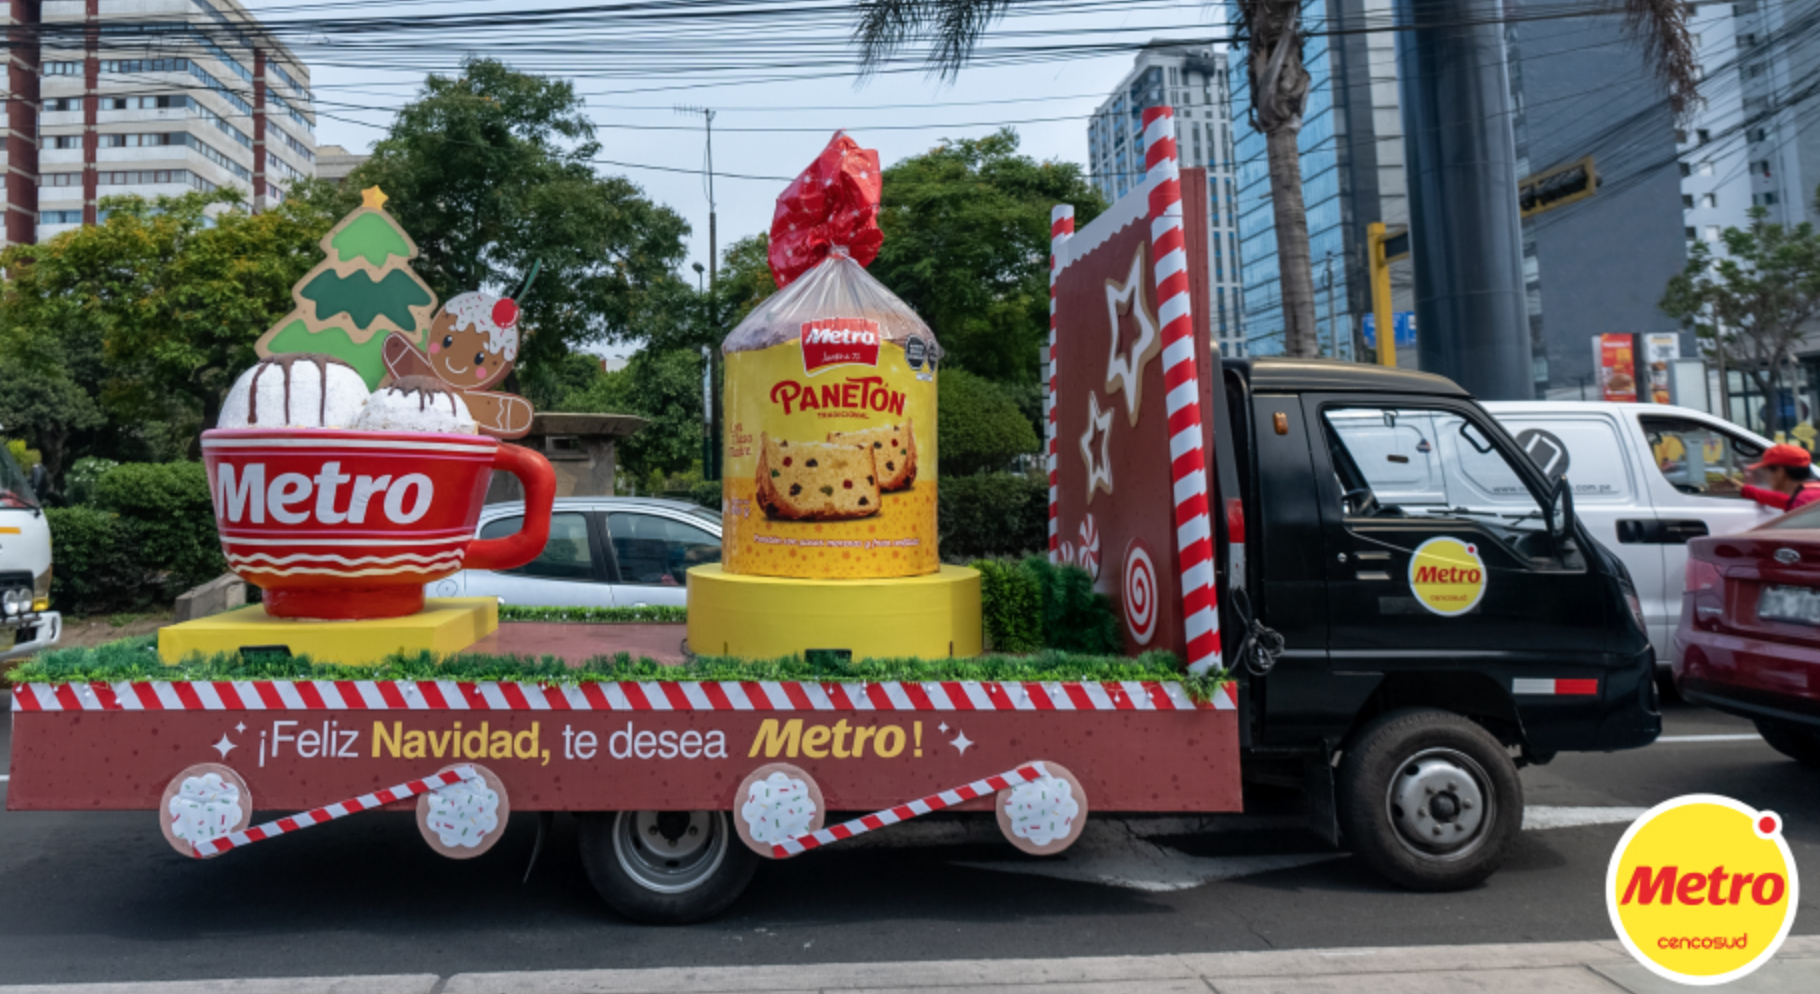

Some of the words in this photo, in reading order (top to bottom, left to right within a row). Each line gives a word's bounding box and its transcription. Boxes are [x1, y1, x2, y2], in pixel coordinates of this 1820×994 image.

[805, 328, 874, 345] Metro
[817, 411, 869, 420] TRADICIONAL
[217, 461, 434, 525] Metro
[1415, 566, 1482, 584] Metro
[1430, 594, 1468, 602] cencosud
[258, 720, 359, 768] ¡Feliz
[371, 720, 551, 767] Navidad,
[562, 724, 598, 760] te
[609, 721, 728, 760] desea
